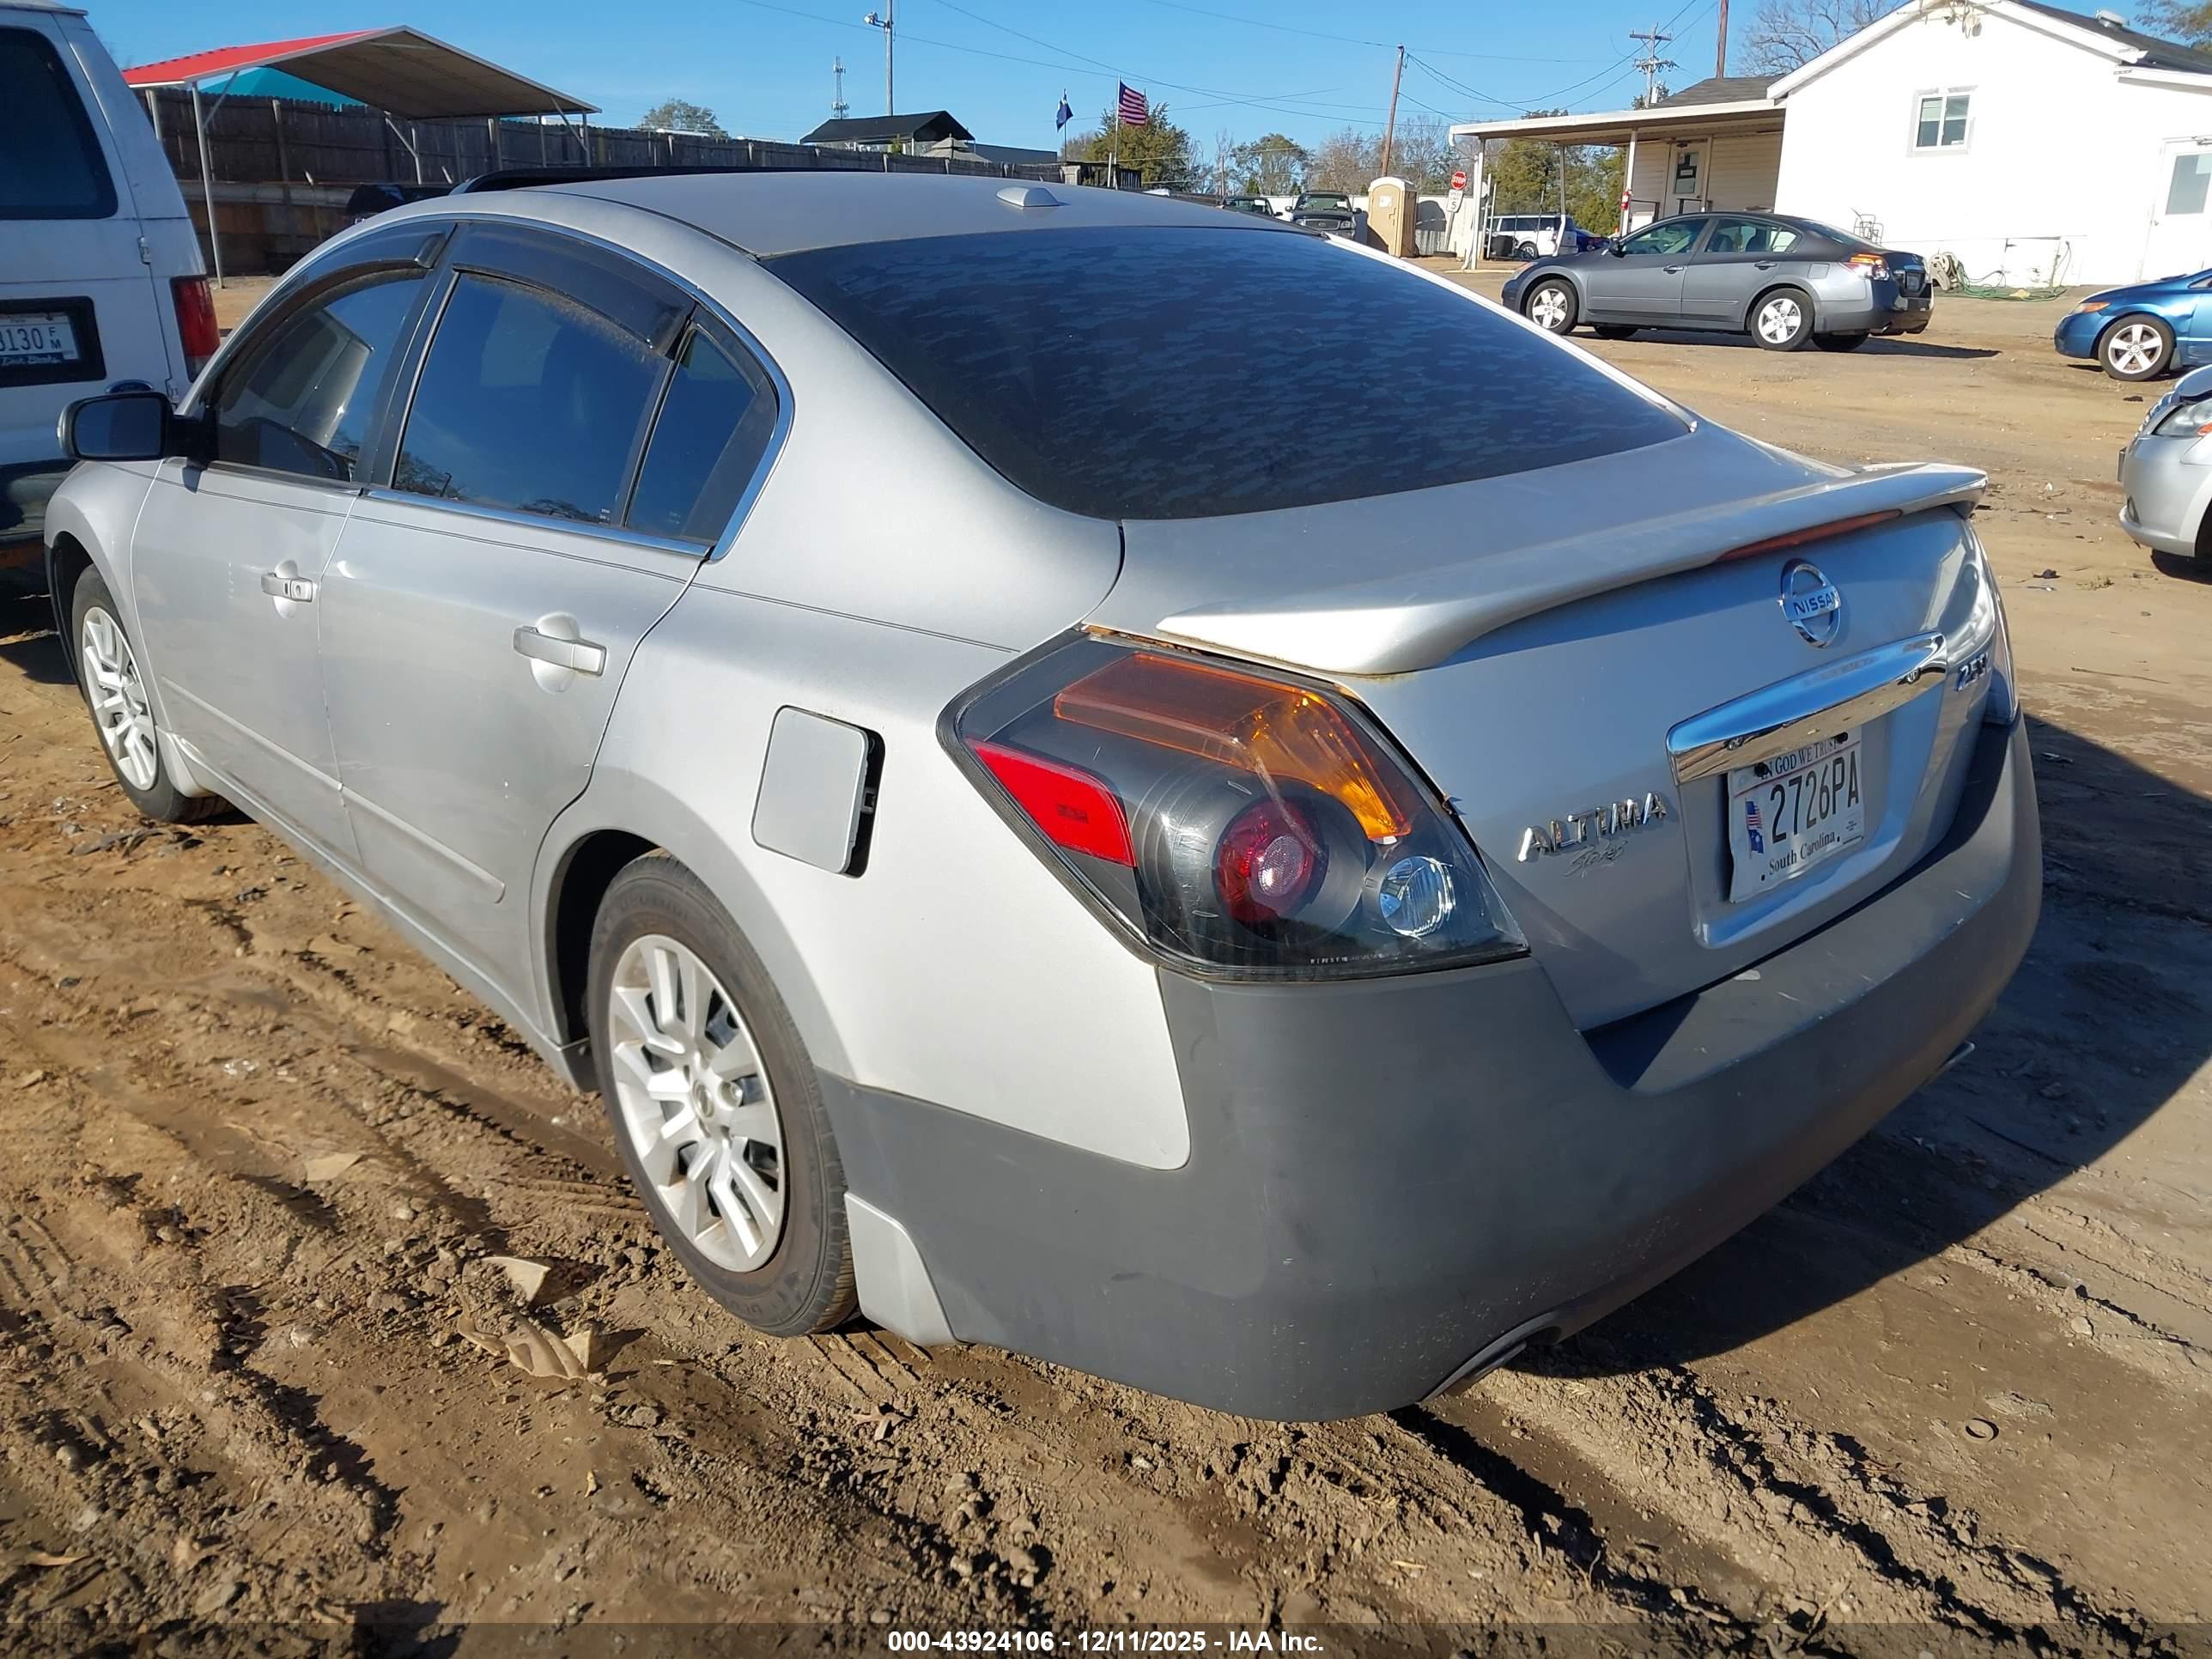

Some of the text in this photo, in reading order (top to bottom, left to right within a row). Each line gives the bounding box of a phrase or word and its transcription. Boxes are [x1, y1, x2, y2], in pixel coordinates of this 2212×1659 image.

[1451, 201, 1458, 210] 5
[1792, 589, 1838, 616] NISSAN
[1775, 753, 1797, 775] GOD
[1797, 746, 1813, 764] WE
[1770, 750, 1859, 844] 2726PA
[1517, 792, 1668, 862] ALTIMA
[1769, 831, 1836, 875] South Carolina
